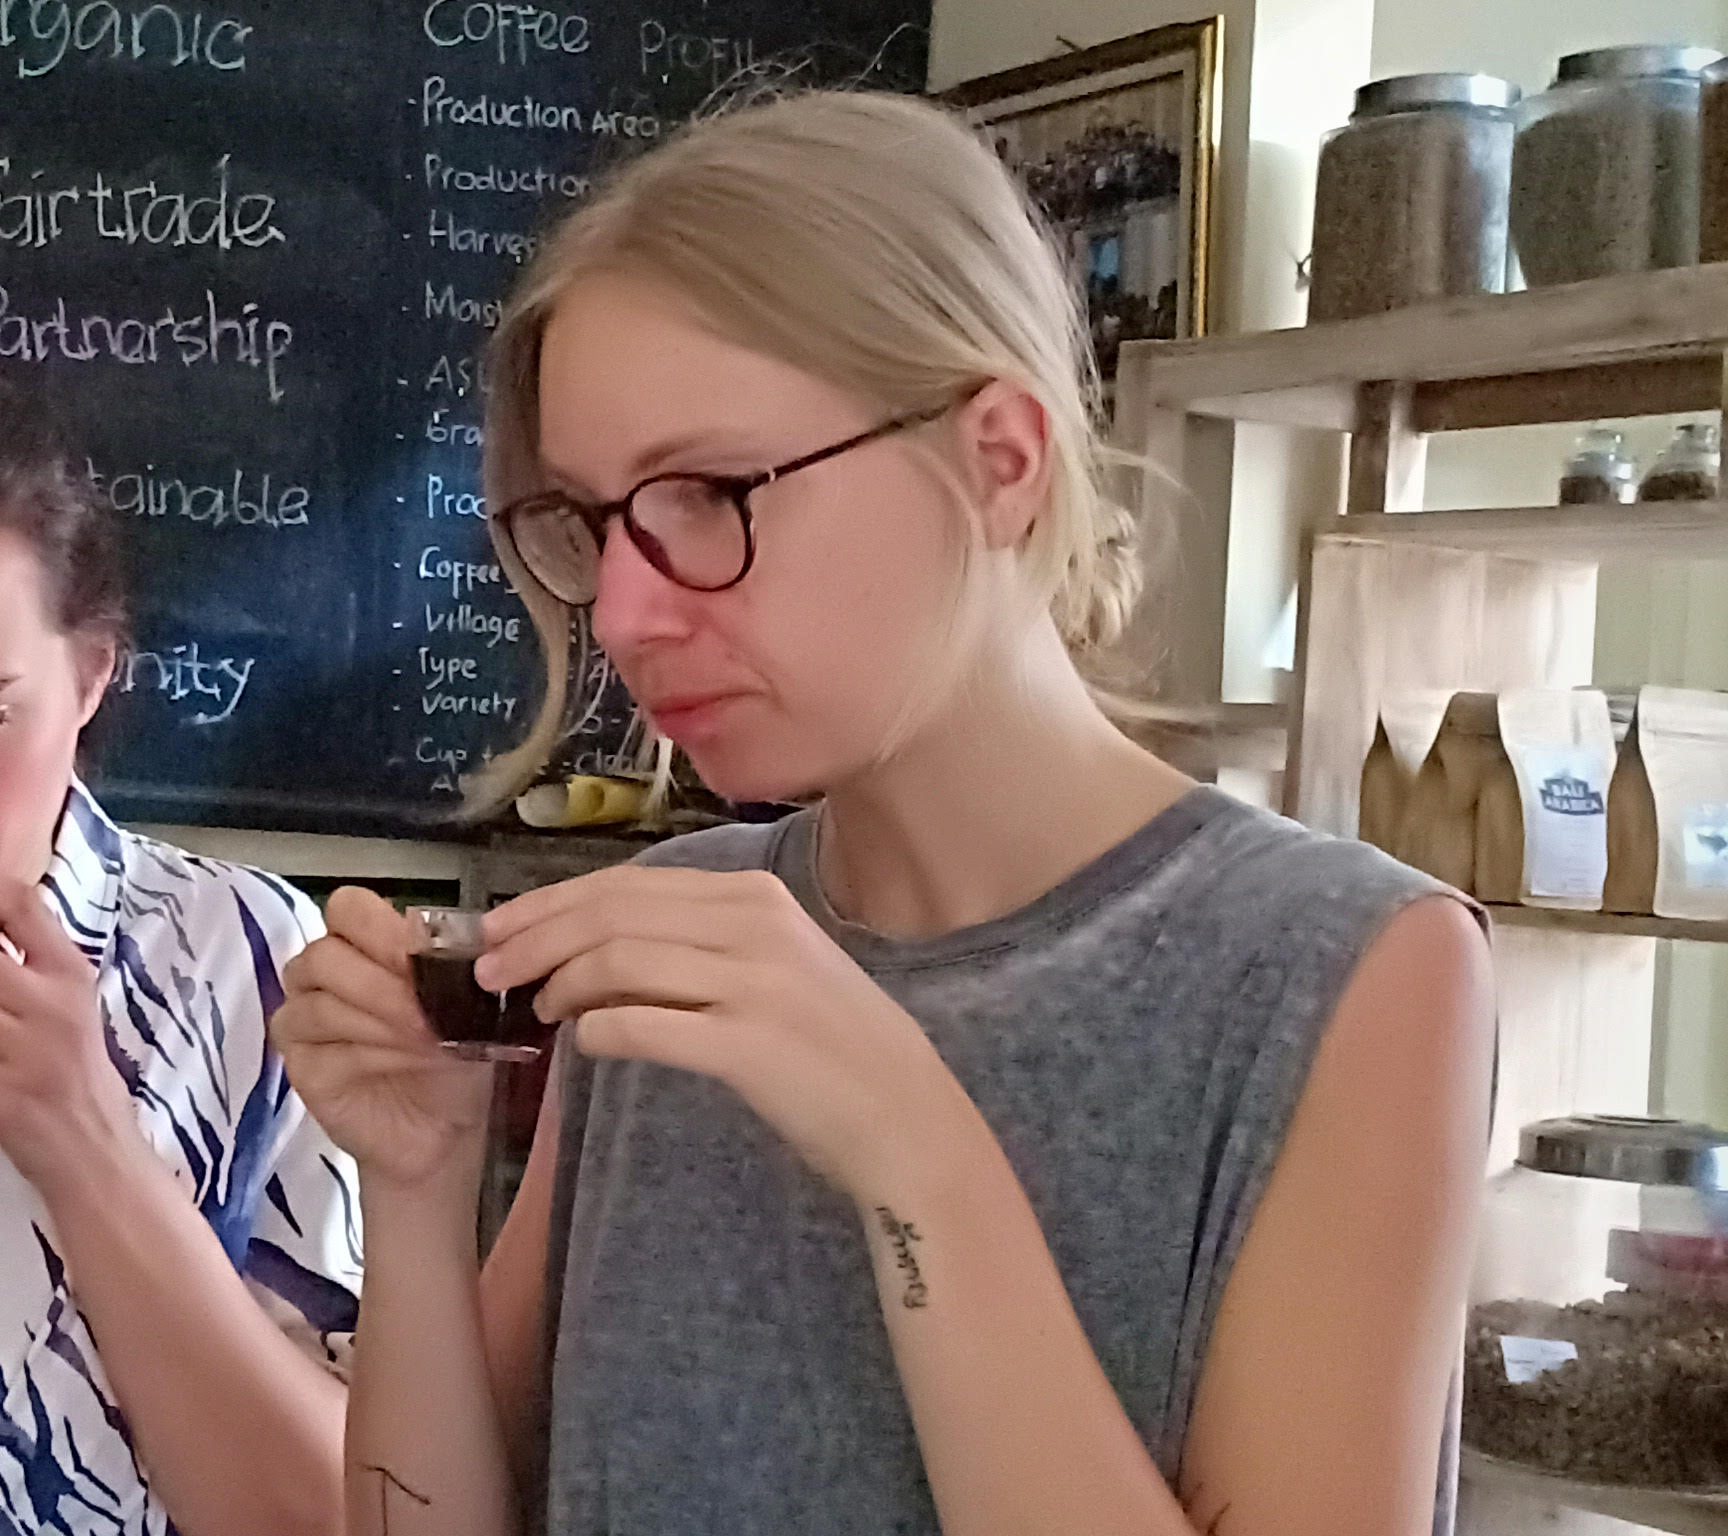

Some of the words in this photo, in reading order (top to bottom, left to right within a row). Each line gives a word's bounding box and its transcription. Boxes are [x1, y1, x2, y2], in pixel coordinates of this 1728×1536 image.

[422, 74, 584, 127] Production
[428, 208, 537, 261] Harves
[84, 456, 312, 531] tainable
[424, 602, 522, 649] Village
[418, 644, 478, 691] Type
